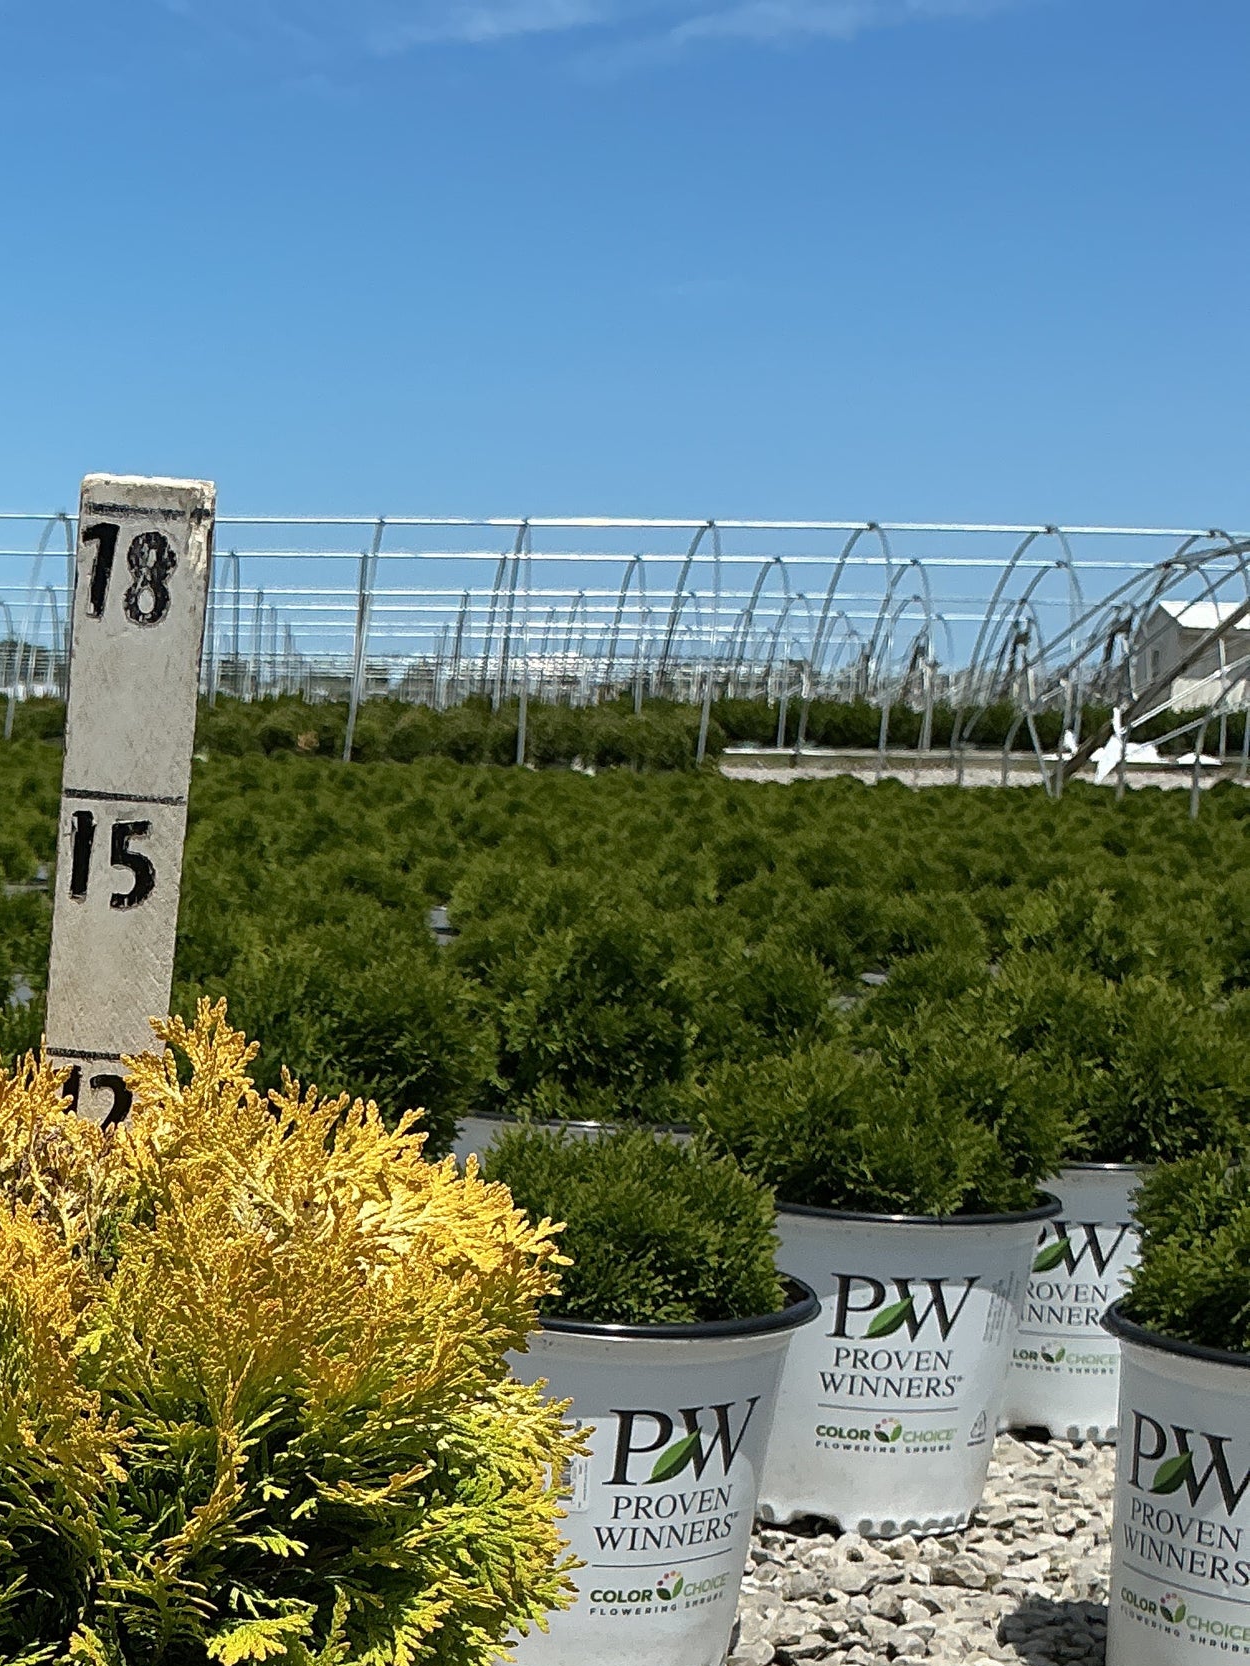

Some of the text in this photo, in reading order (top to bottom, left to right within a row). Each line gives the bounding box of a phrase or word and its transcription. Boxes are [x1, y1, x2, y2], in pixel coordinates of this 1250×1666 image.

[81, 522, 178, 626] 18
[69, 809, 158, 910] 15
[825, 1272, 982, 1343] PW
[1026, 1281, 1110, 1304] ROVEN
[833, 1346, 954, 1372] PROVEN
[602, 1395, 761, 1487] PW
[815, 1424, 871, 1441] COLOR
[902, 1428, 955, 1443] CHOICE
[1128, 1408, 1250, 1517] PW
[610, 1483, 733, 1520] PROVEN
[1130, 1496, 1244, 1553] PROVEN
[1123, 1522, 1250, 1588] WINNERS
[589, 1573, 728, 1604] COLOR CHOICE
[589, 1603, 677, 1617] FLOWERING
[1120, 1586, 1158, 1617] COLOR
